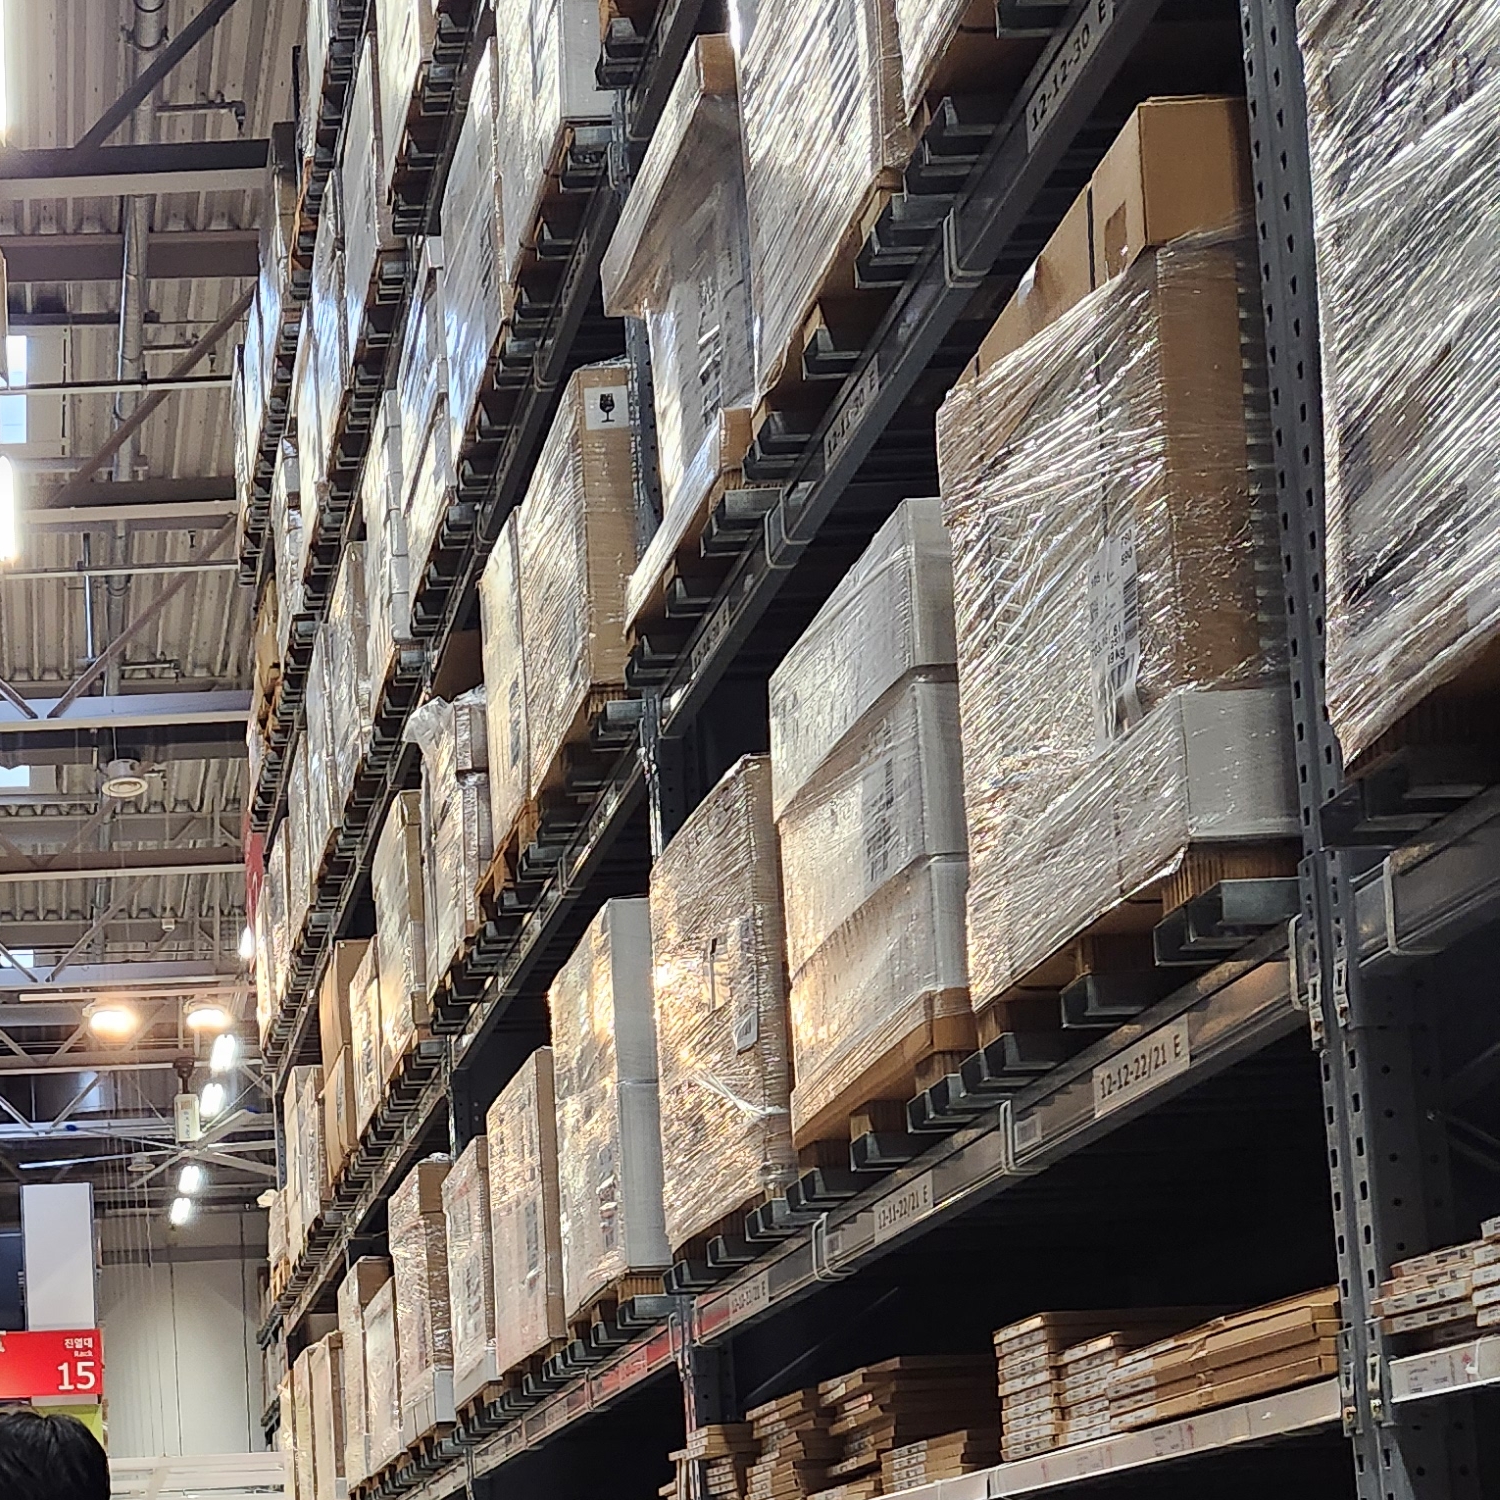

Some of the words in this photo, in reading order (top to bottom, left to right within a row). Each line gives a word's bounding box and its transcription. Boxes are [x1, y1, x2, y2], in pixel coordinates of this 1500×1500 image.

[1031, 23, 1090, 132] 12-12-30
[1097, 1, 1107, 24] E
[1101, 1043, 1167, 1099] 12-12-22/21
[1174, 1033, 1182, 1059] E
[64, 1336, 94, 1349] 진열대
[57, 1361, 96, 1391] 15
